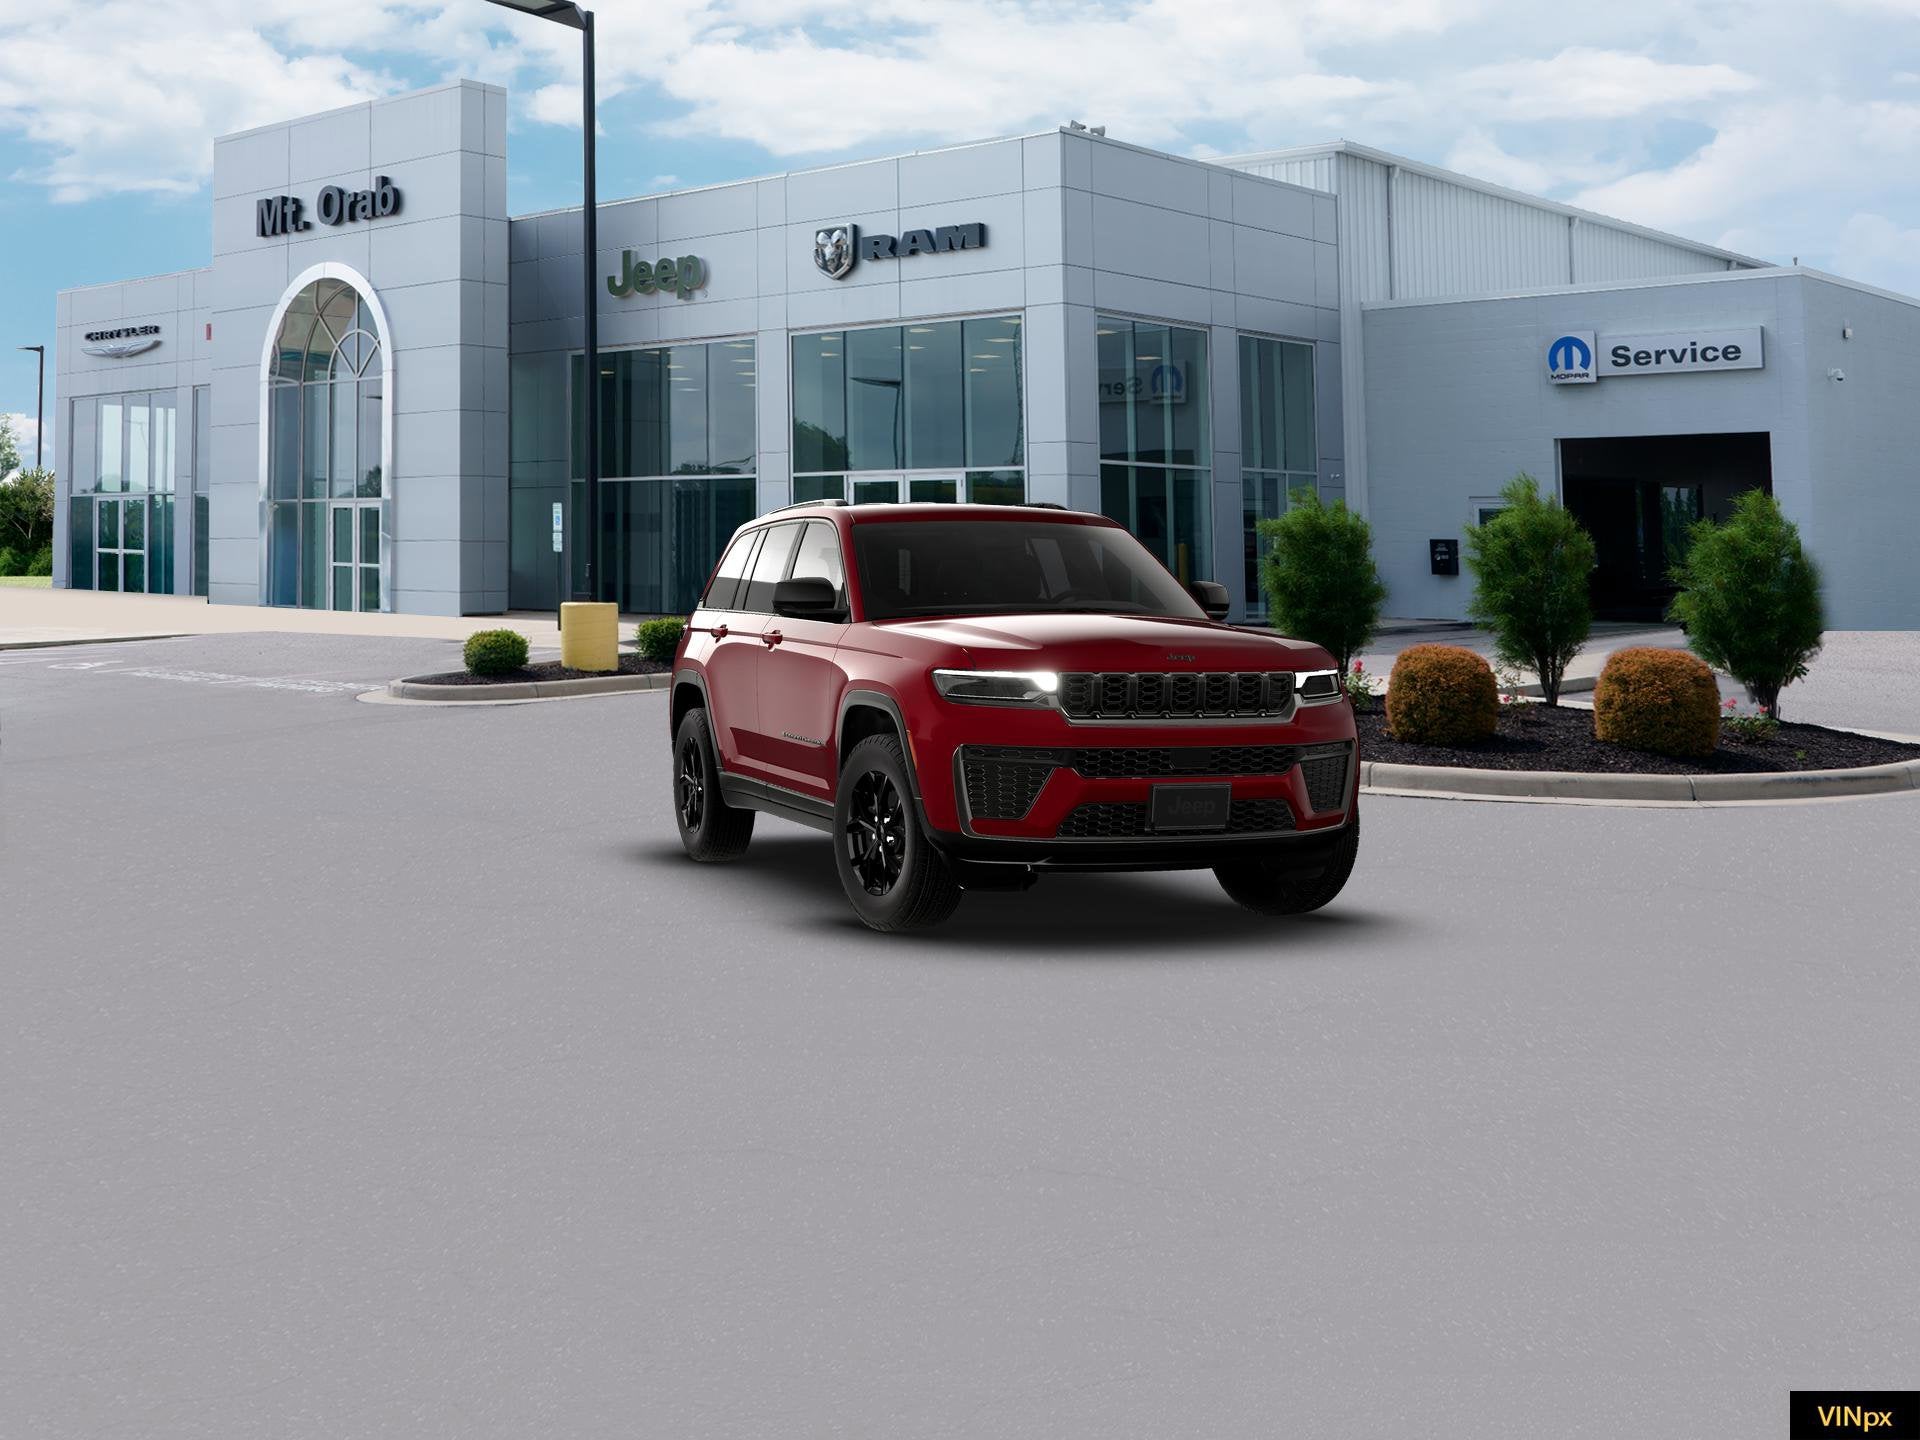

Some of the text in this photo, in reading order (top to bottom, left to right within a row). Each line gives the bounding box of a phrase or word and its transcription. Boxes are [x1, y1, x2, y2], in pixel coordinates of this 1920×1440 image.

[256, 175, 401, 237] Mt. Orab
[861, 223, 986, 260] RAM
[607, 249, 706, 300] Jeep
[85, 325, 161, 341] CHRYSLER
[1611, 341, 1742, 367] Service
[1550, 372, 1590, 380] MOPAR
[1167, 795, 1217, 817] Jeep
